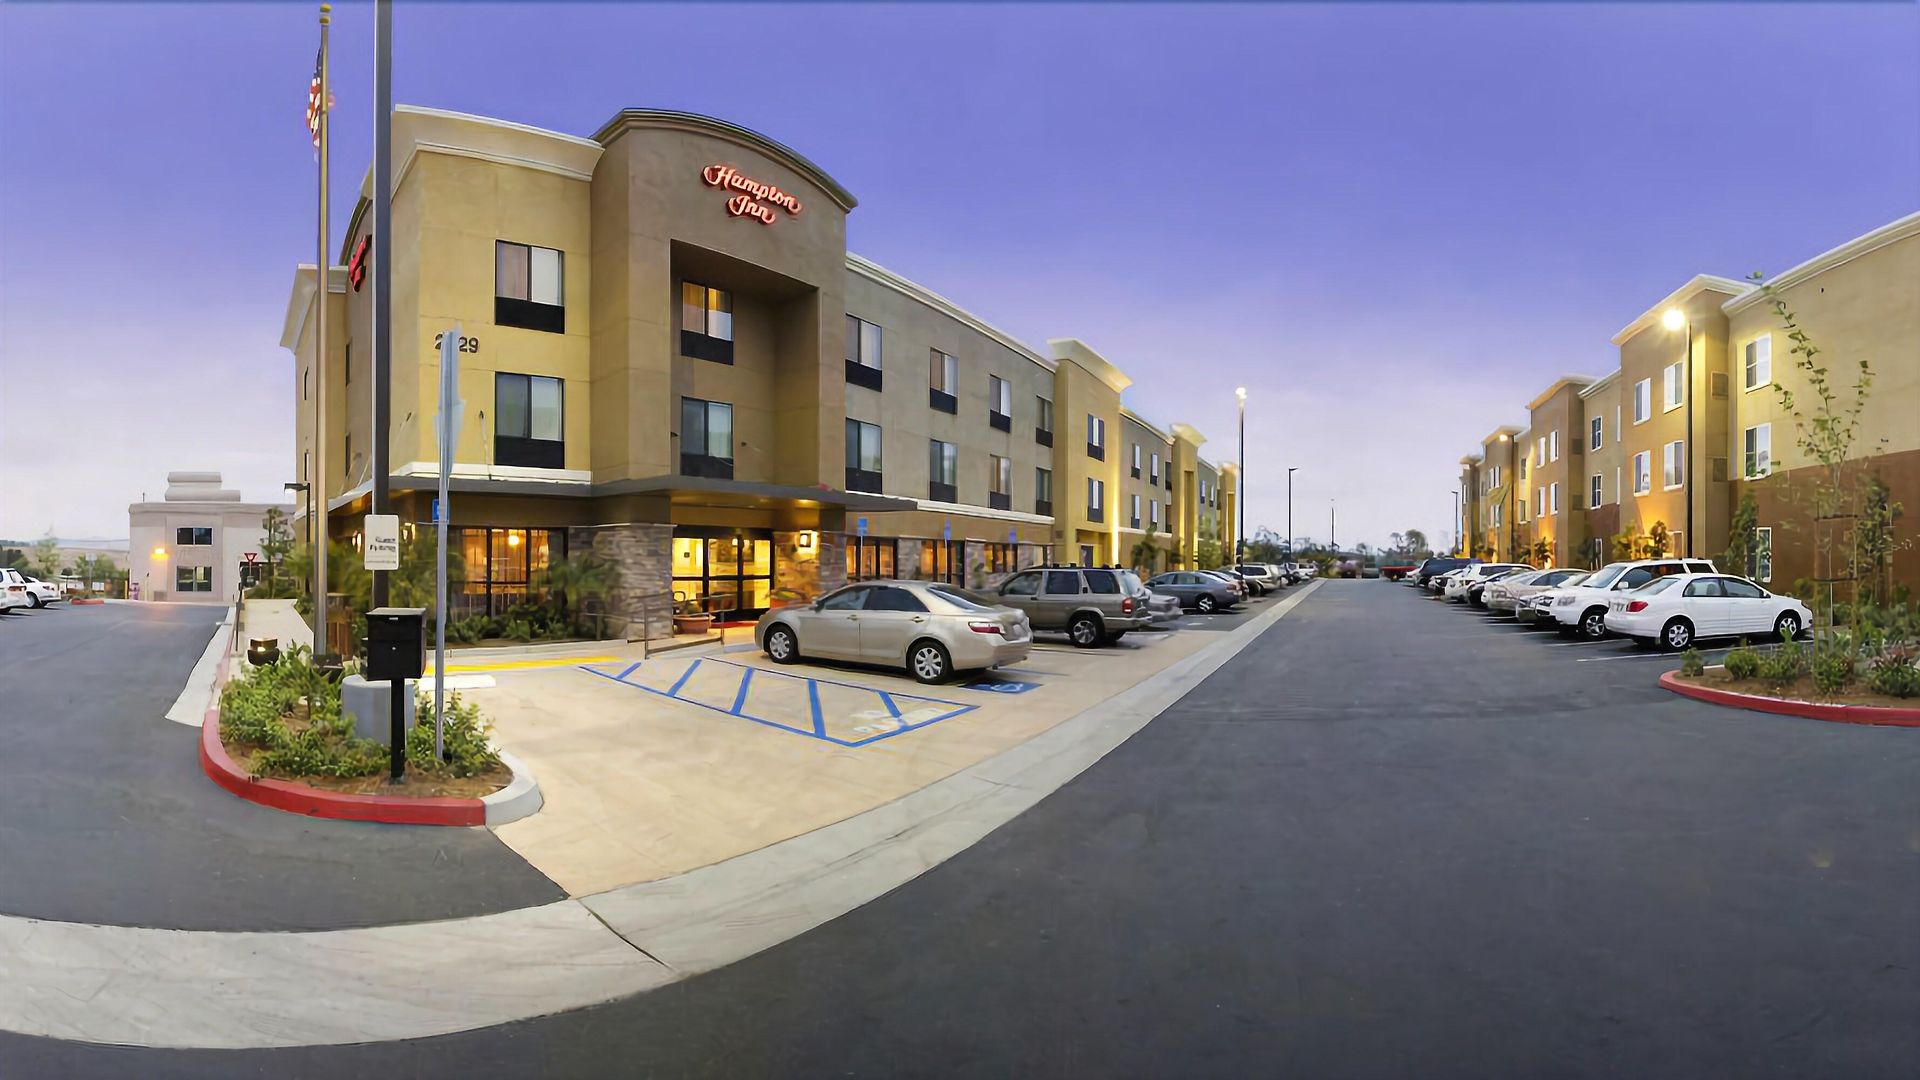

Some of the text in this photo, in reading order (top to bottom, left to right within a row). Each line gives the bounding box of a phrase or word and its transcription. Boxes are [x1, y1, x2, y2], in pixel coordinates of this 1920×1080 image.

[703, 164, 802, 213] Hampton
[728, 195, 776, 224] Inn
[434, 333, 479, 353] 229
